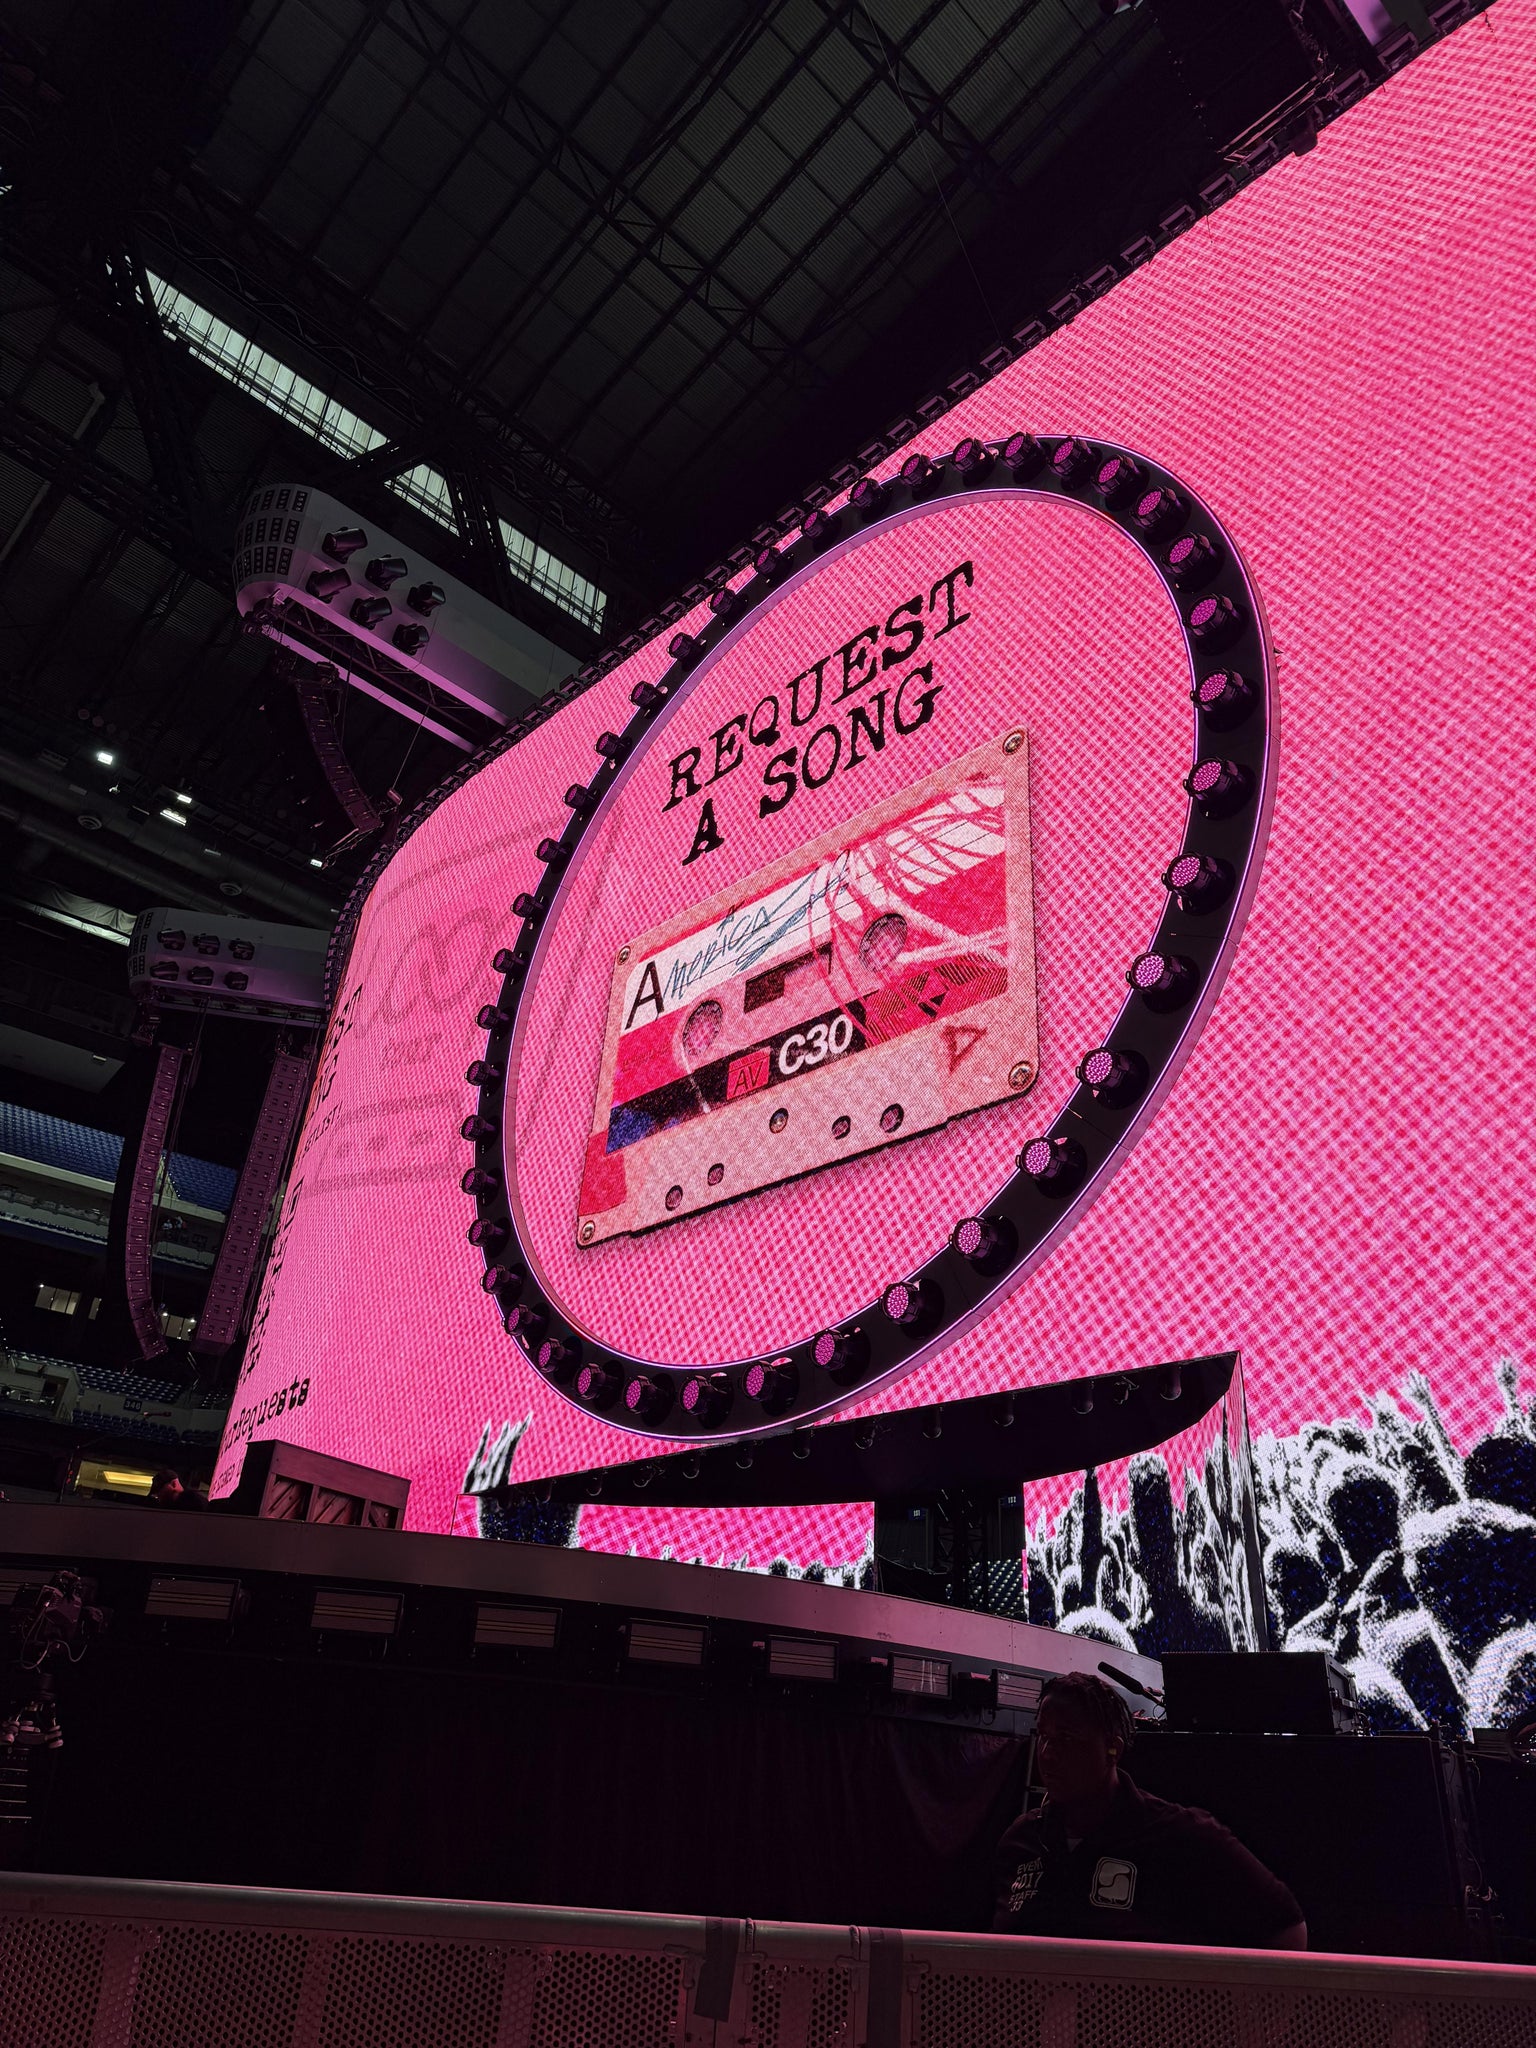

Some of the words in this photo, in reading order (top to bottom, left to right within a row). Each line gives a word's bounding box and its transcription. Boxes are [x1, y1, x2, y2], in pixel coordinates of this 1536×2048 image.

[662, 560, 974, 813] REQUEST
[682, 798, 724, 866] A
[759, 660, 944, 819] SONG
[733, 1061, 764, 1098] AV
[778, 1014, 854, 1076] C30
[1010, 1889, 1038, 1901] STAFF
